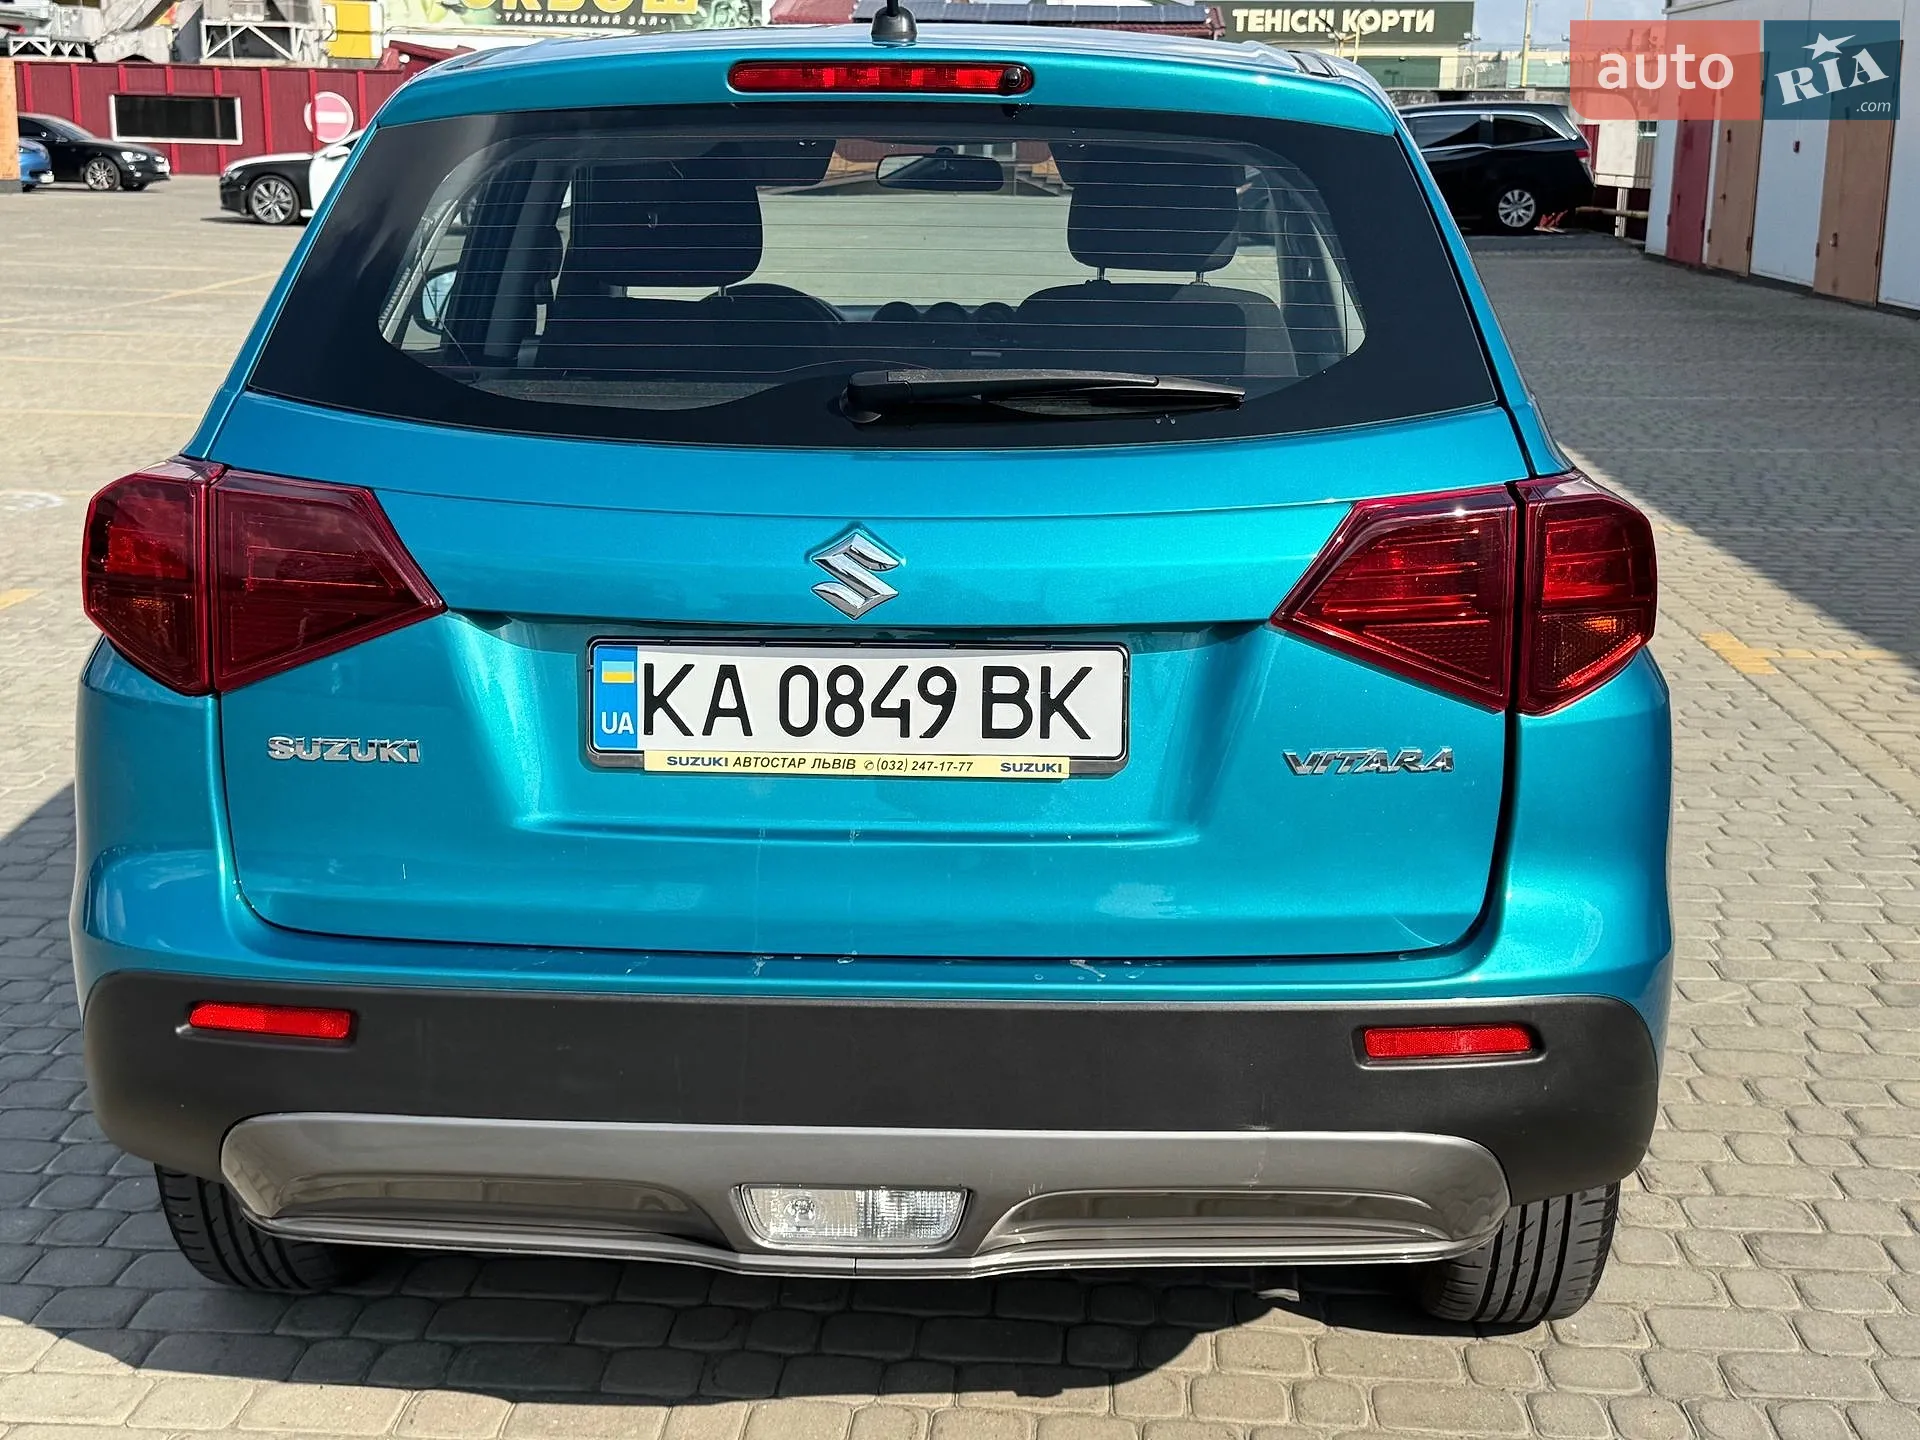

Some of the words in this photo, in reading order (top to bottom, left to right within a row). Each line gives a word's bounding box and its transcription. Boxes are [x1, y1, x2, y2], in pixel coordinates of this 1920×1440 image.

[1232, 9, 1334, 33] ТЕНІСНІ
[1342, 9, 1435, 33] КОРТИ
[643, 663, 753, 737] KA
[778, 664, 958, 739] 0849
[981, 666, 1094, 740] BK
[601, 711, 635, 735] UA
[266, 735, 421, 764] SUZUKI
[1283, 746, 1455, 776] VITARA
[666, 756, 729, 768] SUZUKI
[732, 756, 807, 770] АВТОСТАР
[811, 758, 857, 770] ЛЬВІВ
[876, 757, 909, 772] (032)
[911, 760, 974, 773] 247-17-77
[1000, 762, 1063, 774] SUZUKI
